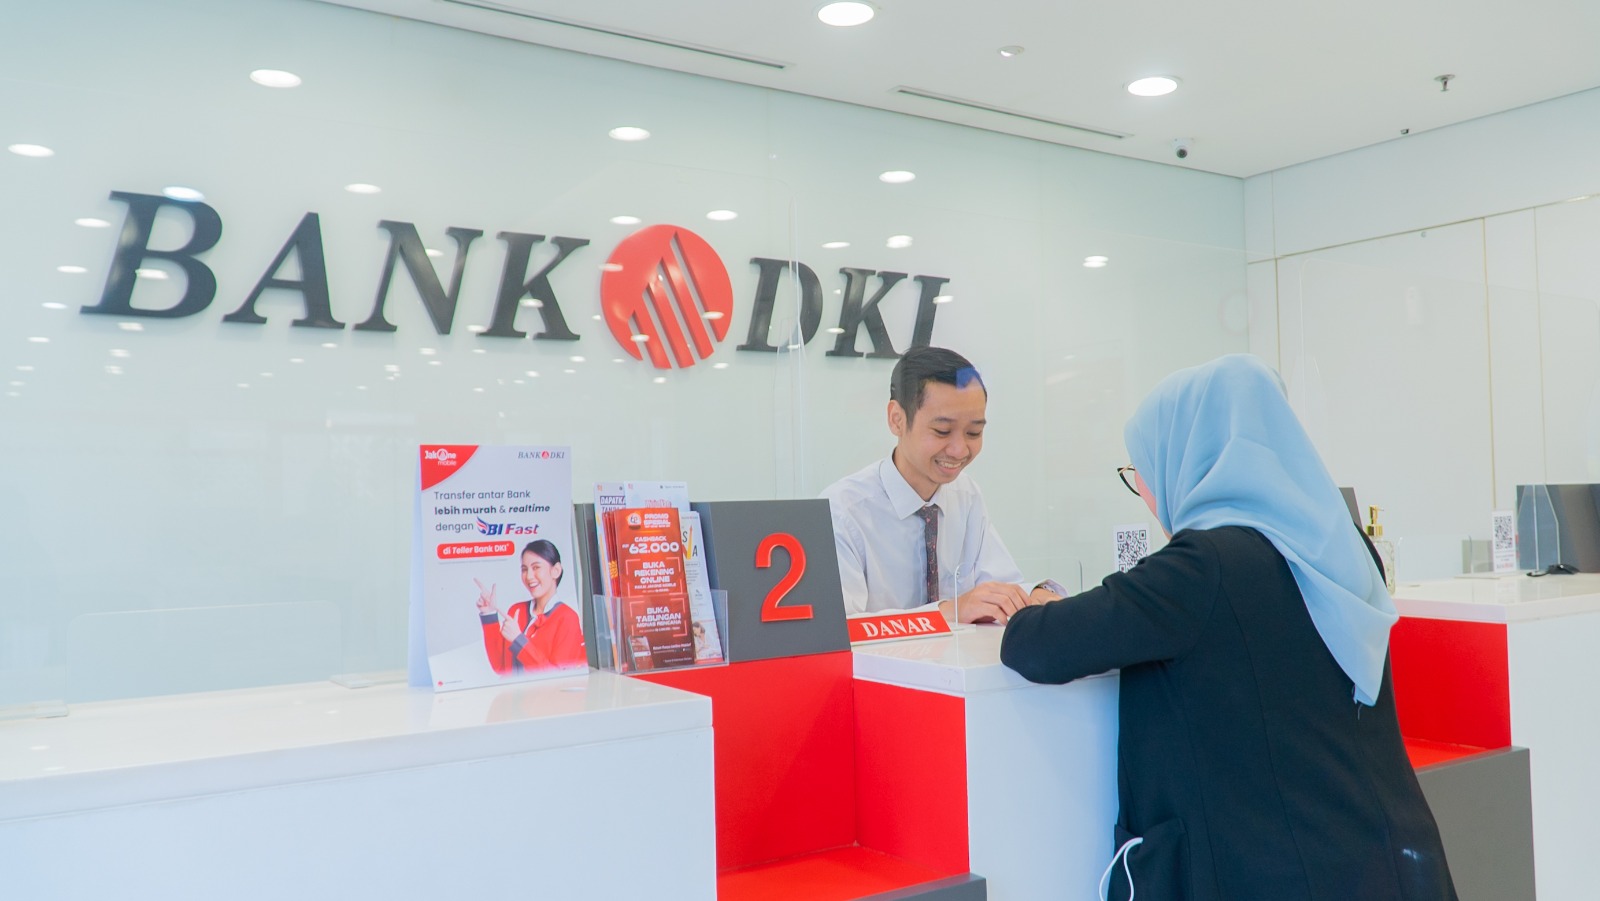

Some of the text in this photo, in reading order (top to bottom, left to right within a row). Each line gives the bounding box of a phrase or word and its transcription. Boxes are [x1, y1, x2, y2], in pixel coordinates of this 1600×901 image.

[80, 190, 950, 358] BANK DKI
[518, 451, 565, 459] BANK DKI
[434, 490, 531, 500] Transfer antar Bank
[434, 504, 551, 515] lebih murah & realtime
[435, 522, 540, 536] dengan BI Fast
[442, 546, 451, 555] di
[452, 546, 473, 555] Teller
[474, 545, 493, 554] Bank
[628, 541, 680, 554] 62.000
[643, 561, 666, 569] BUKA
[634, 568, 675, 577] REKENING
[755, 532, 814, 623] 2
[640, 576, 671, 584] ONLINE
[646, 606, 670, 614] BUKA
[636, 613, 681, 622] TABUNGAN
[860, 616, 936, 638] DANAR
